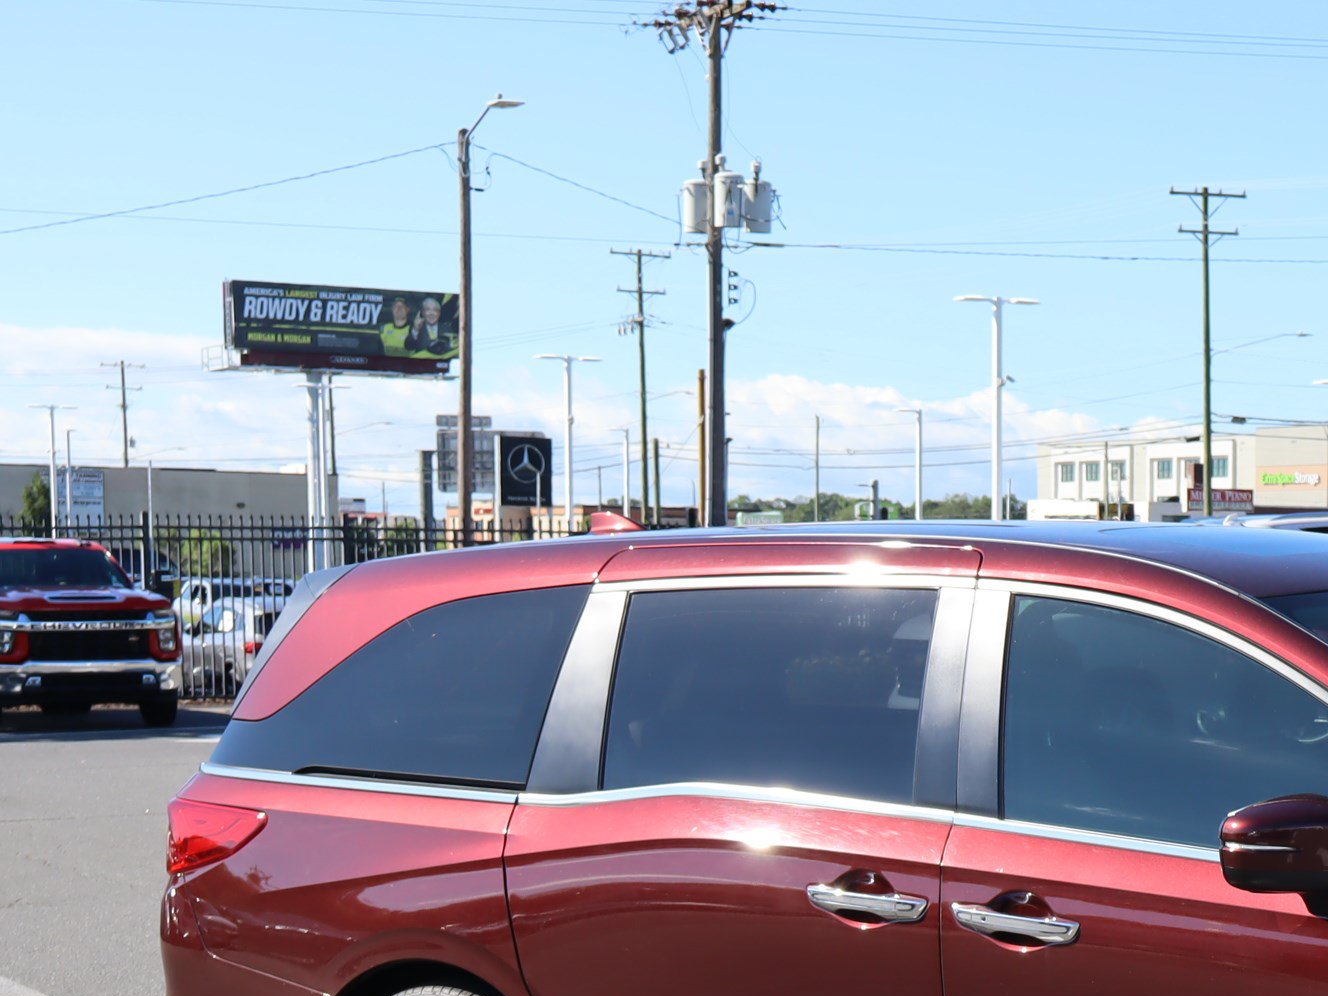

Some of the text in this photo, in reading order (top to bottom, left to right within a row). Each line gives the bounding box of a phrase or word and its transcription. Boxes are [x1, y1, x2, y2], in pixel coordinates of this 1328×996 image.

[243, 296, 383, 325] ROWDY & READY
